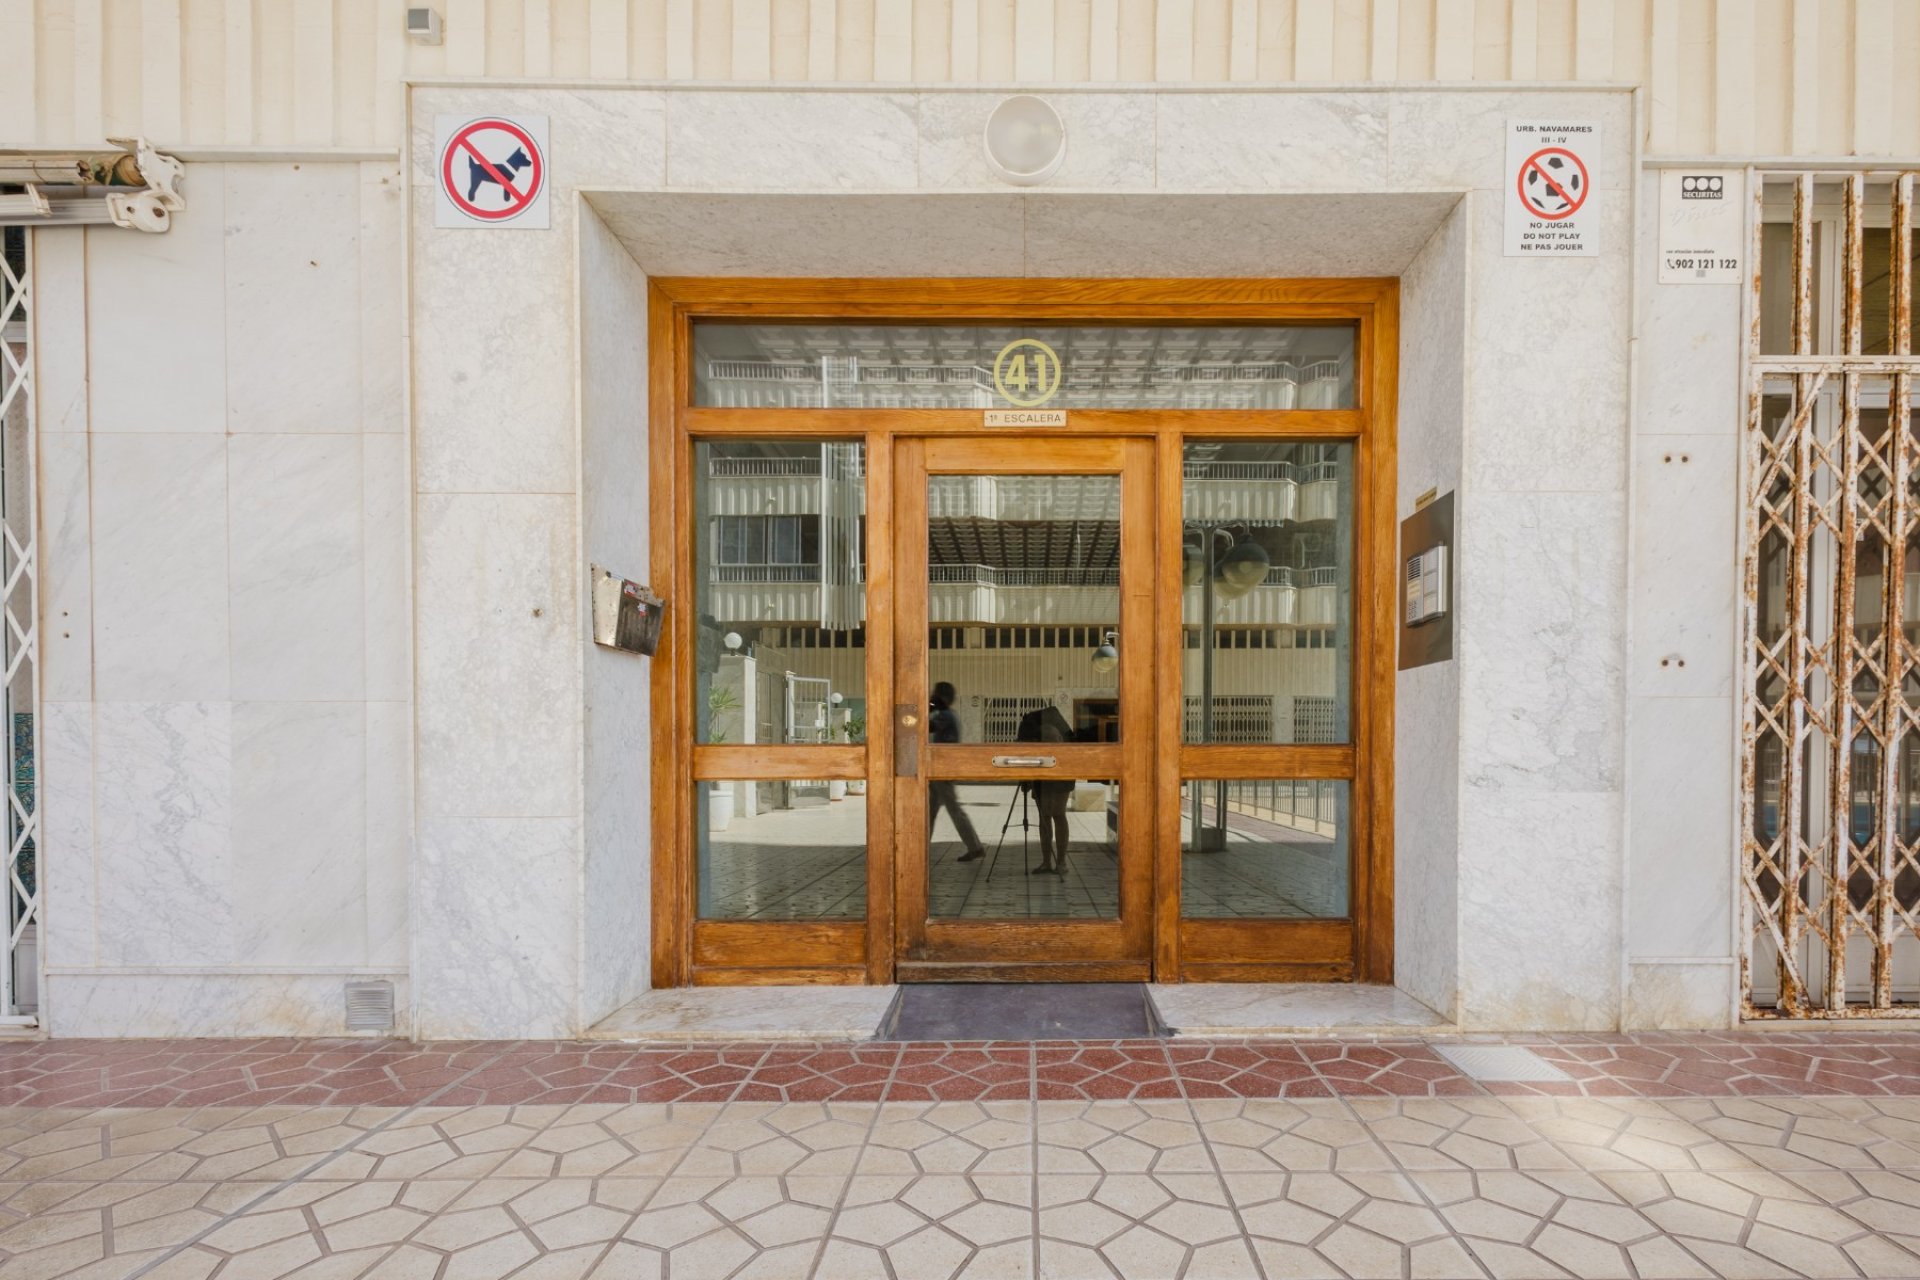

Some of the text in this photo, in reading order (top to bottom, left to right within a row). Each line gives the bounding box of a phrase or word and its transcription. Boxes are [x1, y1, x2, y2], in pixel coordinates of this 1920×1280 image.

[1516, 125, 1537, 133] URB.
[1675, 259, 1737, 269] 902 121 122
[1005, 354, 1047, 393] 41
[1004, 413, 1061, 423] ESCALERA
